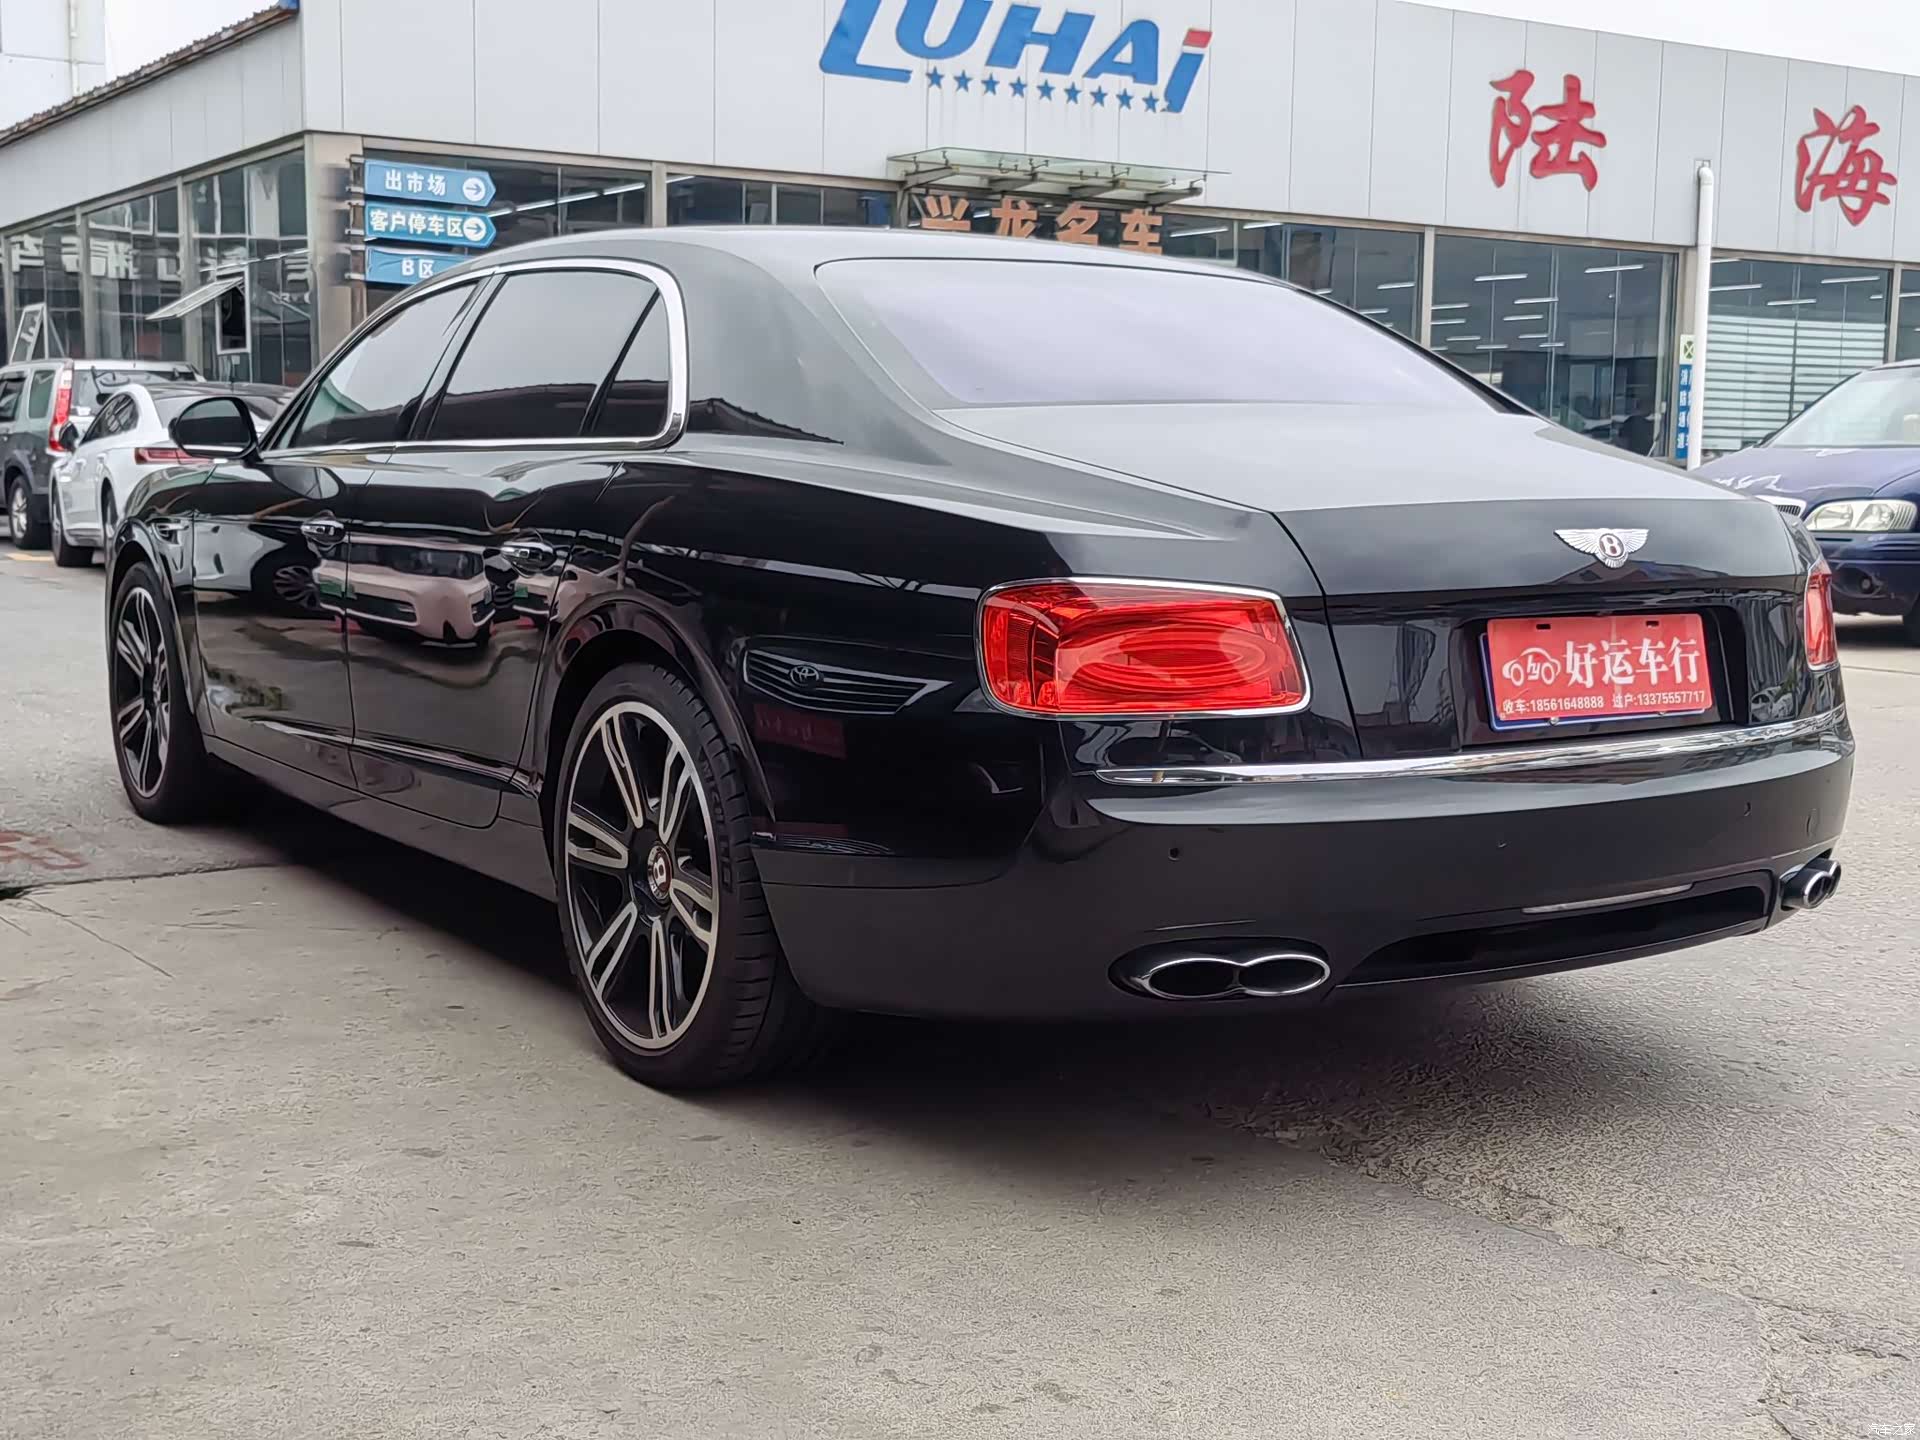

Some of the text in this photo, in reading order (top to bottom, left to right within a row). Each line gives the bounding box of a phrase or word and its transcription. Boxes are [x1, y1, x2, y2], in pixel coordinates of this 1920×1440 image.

[385, 169, 446, 196] 出市场
[370, 209, 464, 237] 客户停车区
[402, 257, 434, 279] B区
[1563, 636, 1700, 688] 好运车行
